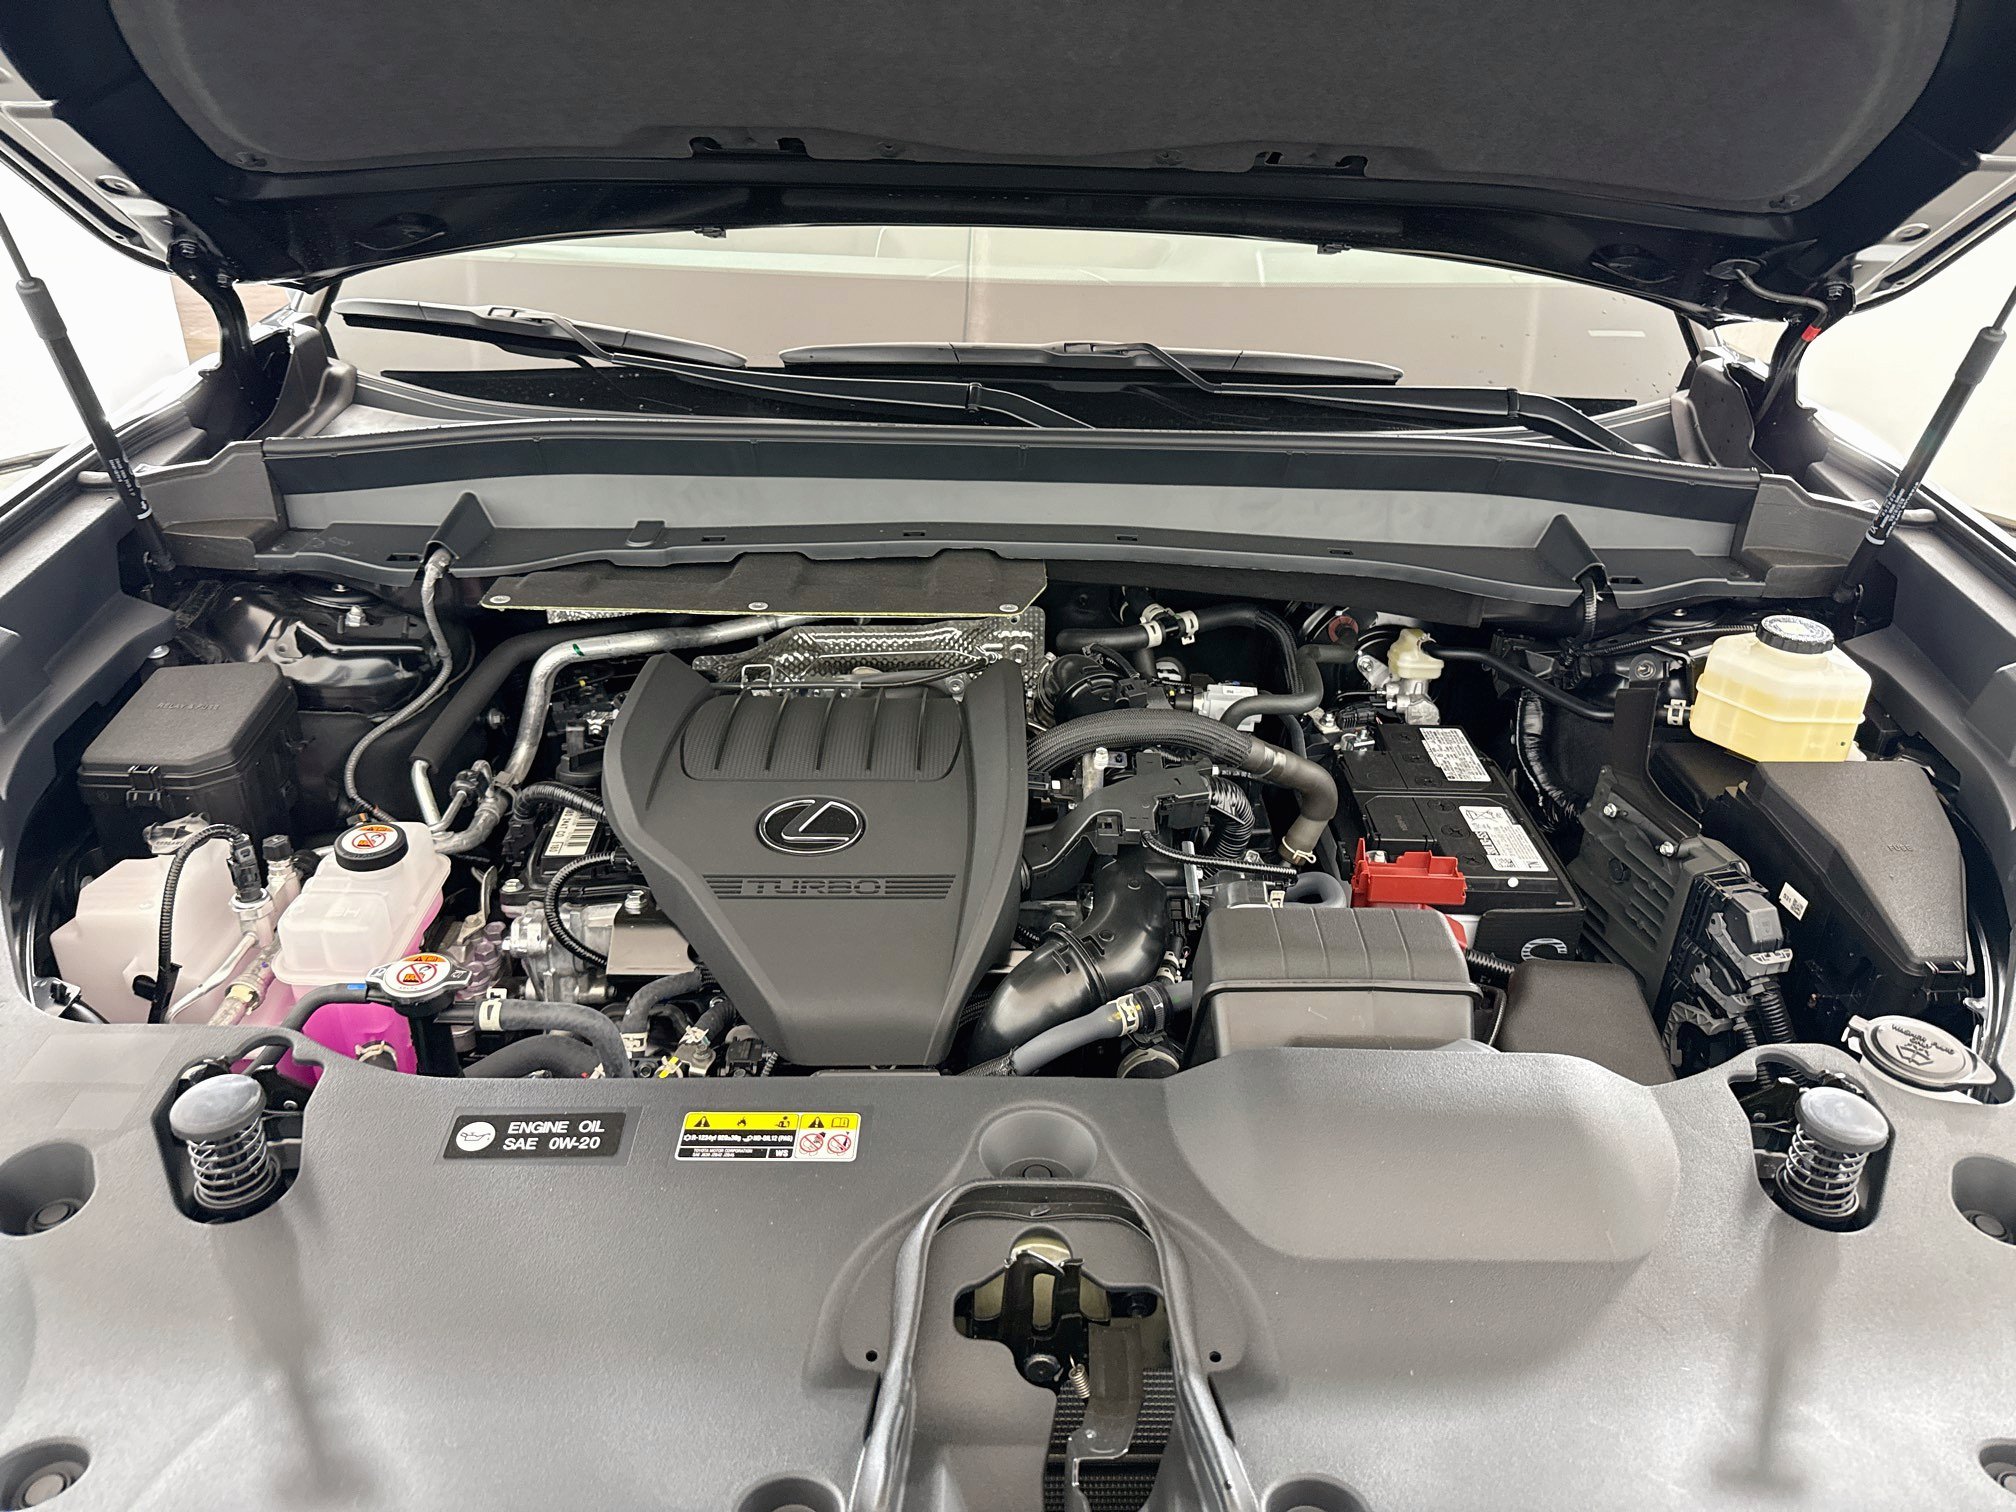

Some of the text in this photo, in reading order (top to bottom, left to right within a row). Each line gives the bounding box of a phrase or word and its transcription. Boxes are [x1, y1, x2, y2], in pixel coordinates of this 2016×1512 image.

[1887, 844, 1914, 852] FUSE
[747, 879, 881, 894] TURBO
[508, 1120, 605, 1134] ENGINE OIL
[503, 1136, 601, 1150] SAE 0W-20
[775, 1149, 789, 1157] WS
